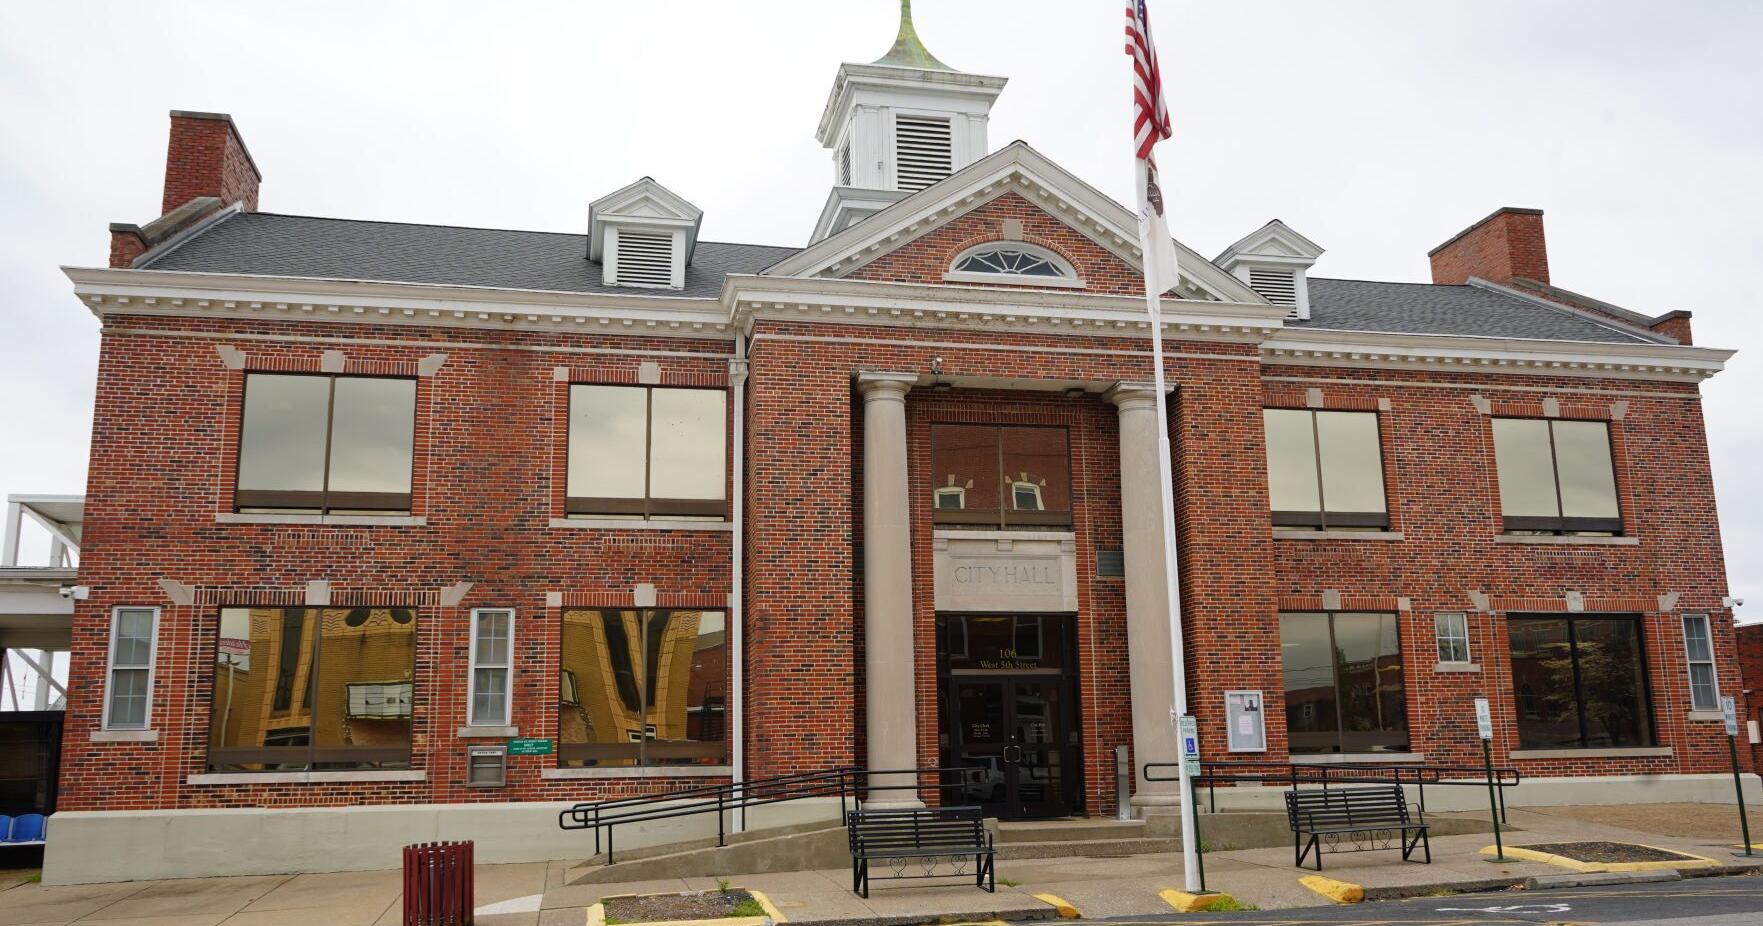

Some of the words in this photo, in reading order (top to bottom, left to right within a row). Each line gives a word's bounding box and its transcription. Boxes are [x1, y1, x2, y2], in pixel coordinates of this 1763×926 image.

[954, 566, 1001, 584] CITY
[1005, 566, 1056, 584] HALL
[999, 648, 1017, 659] 106
[980, 660, 998, 669] West
[1001, 660, 1013, 669] 5th
[1015, 661, 1037, 670] Street
